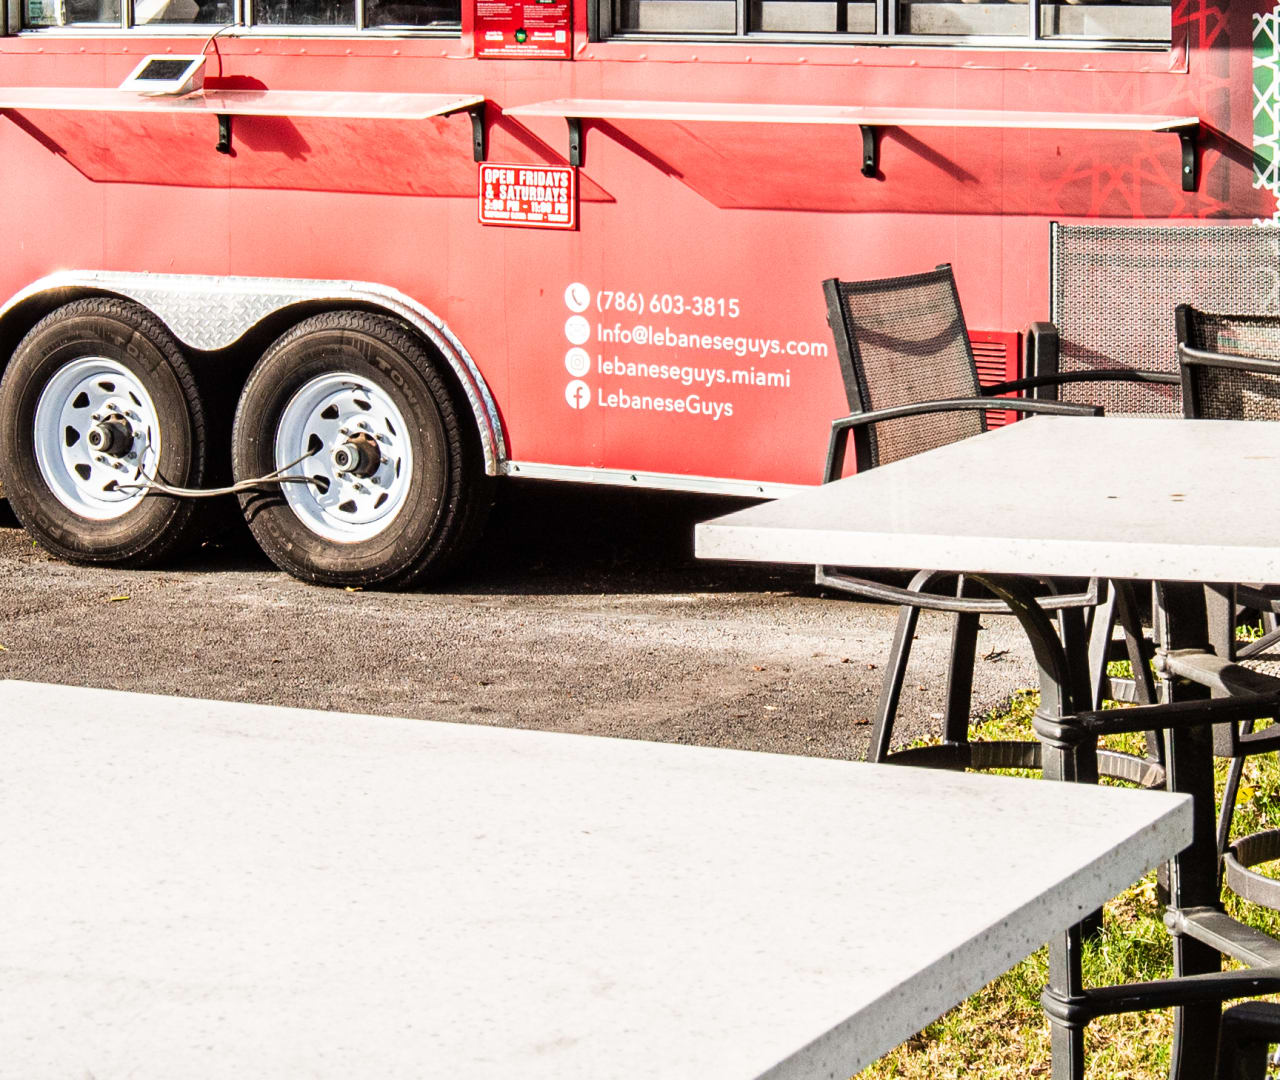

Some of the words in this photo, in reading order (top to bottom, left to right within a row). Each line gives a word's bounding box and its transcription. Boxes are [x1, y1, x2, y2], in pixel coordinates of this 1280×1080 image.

[484, 169, 515, 185] OPEN
[519, 170, 569, 187] FRIDAYS
[485, 184, 494, 199] &
[499, 185, 568, 202] SATURDAYS
[506, 200, 520, 212] PM
[554, 202, 569, 214] PM
[596, 290, 645, 315] (786)
[649, 294, 740, 318] 603-3815
[597, 323, 829, 358] Info@lebaneseguys.com
[597, 354, 791, 388] lebaneseguys.miami
[597, 387, 734, 421] LebaneseGuys
